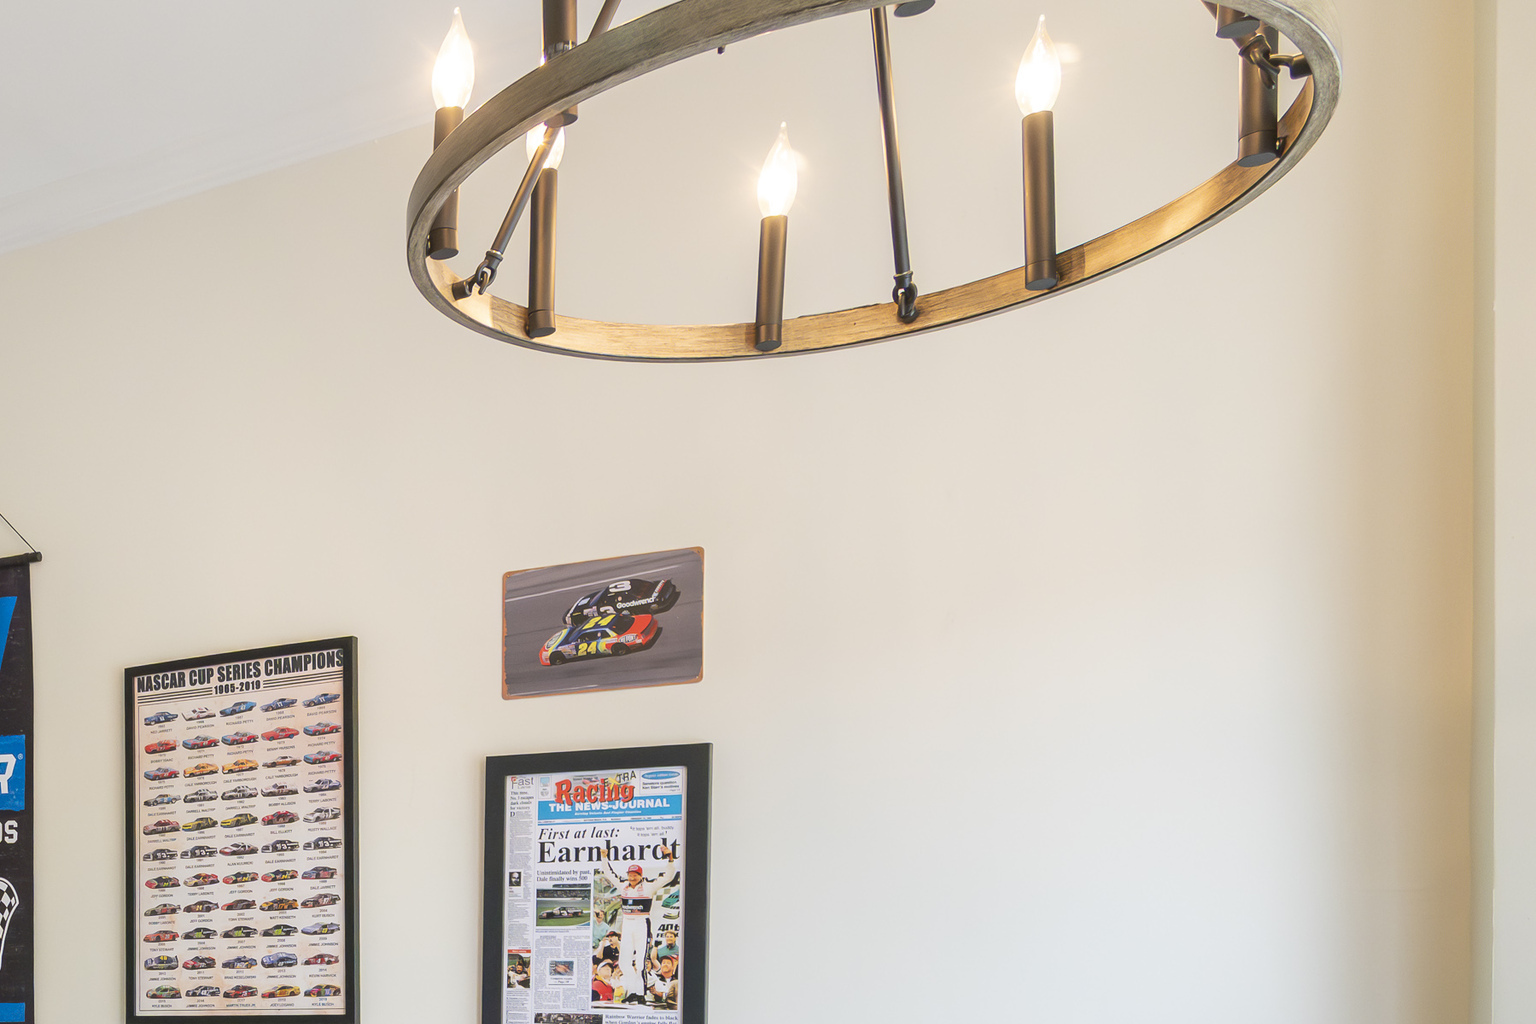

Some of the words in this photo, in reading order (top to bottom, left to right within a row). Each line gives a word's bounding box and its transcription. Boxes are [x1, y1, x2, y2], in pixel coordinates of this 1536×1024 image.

[609, 580, 632, 593] 3
[578, 641, 597, 656] 24
[137, 671, 186, 693] NASCAR
[189, 668, 214, 686] CUP
[217, 661, 261, 683] SERIES
[264, 649, 343, 677] CHAMPIONS
[214, 679, 261, 695] 1965-2019
[554, 778, 635, 806] Racing
[548, 803, 572, 812] THE
[575, 798, 670, 811] NEWS-JOURNAL
[538, 828, 571, 840] First
[573, 829, 587, 839] at
[590, 826, 620, 839] last:
[537, 837, 681, 863] Earnhardt
